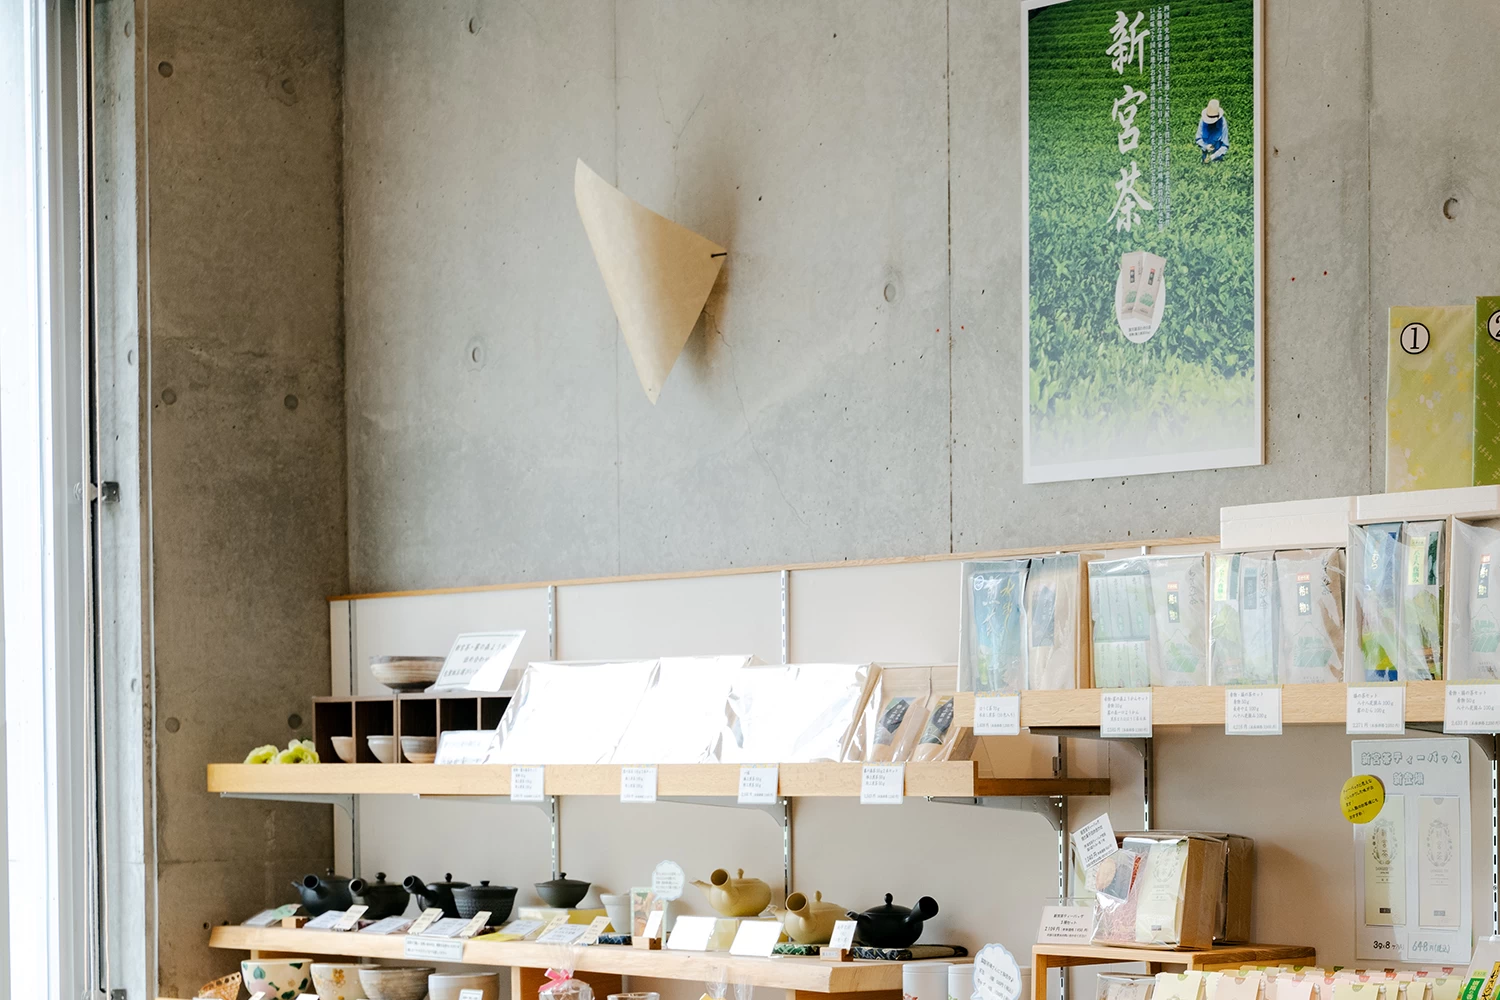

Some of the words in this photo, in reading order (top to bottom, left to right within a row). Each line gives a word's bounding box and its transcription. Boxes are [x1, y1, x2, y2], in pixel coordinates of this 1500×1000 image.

[1105, 10, 1154, 233] 新宮茶
[1393, 772, 1424, 786] 新登場
